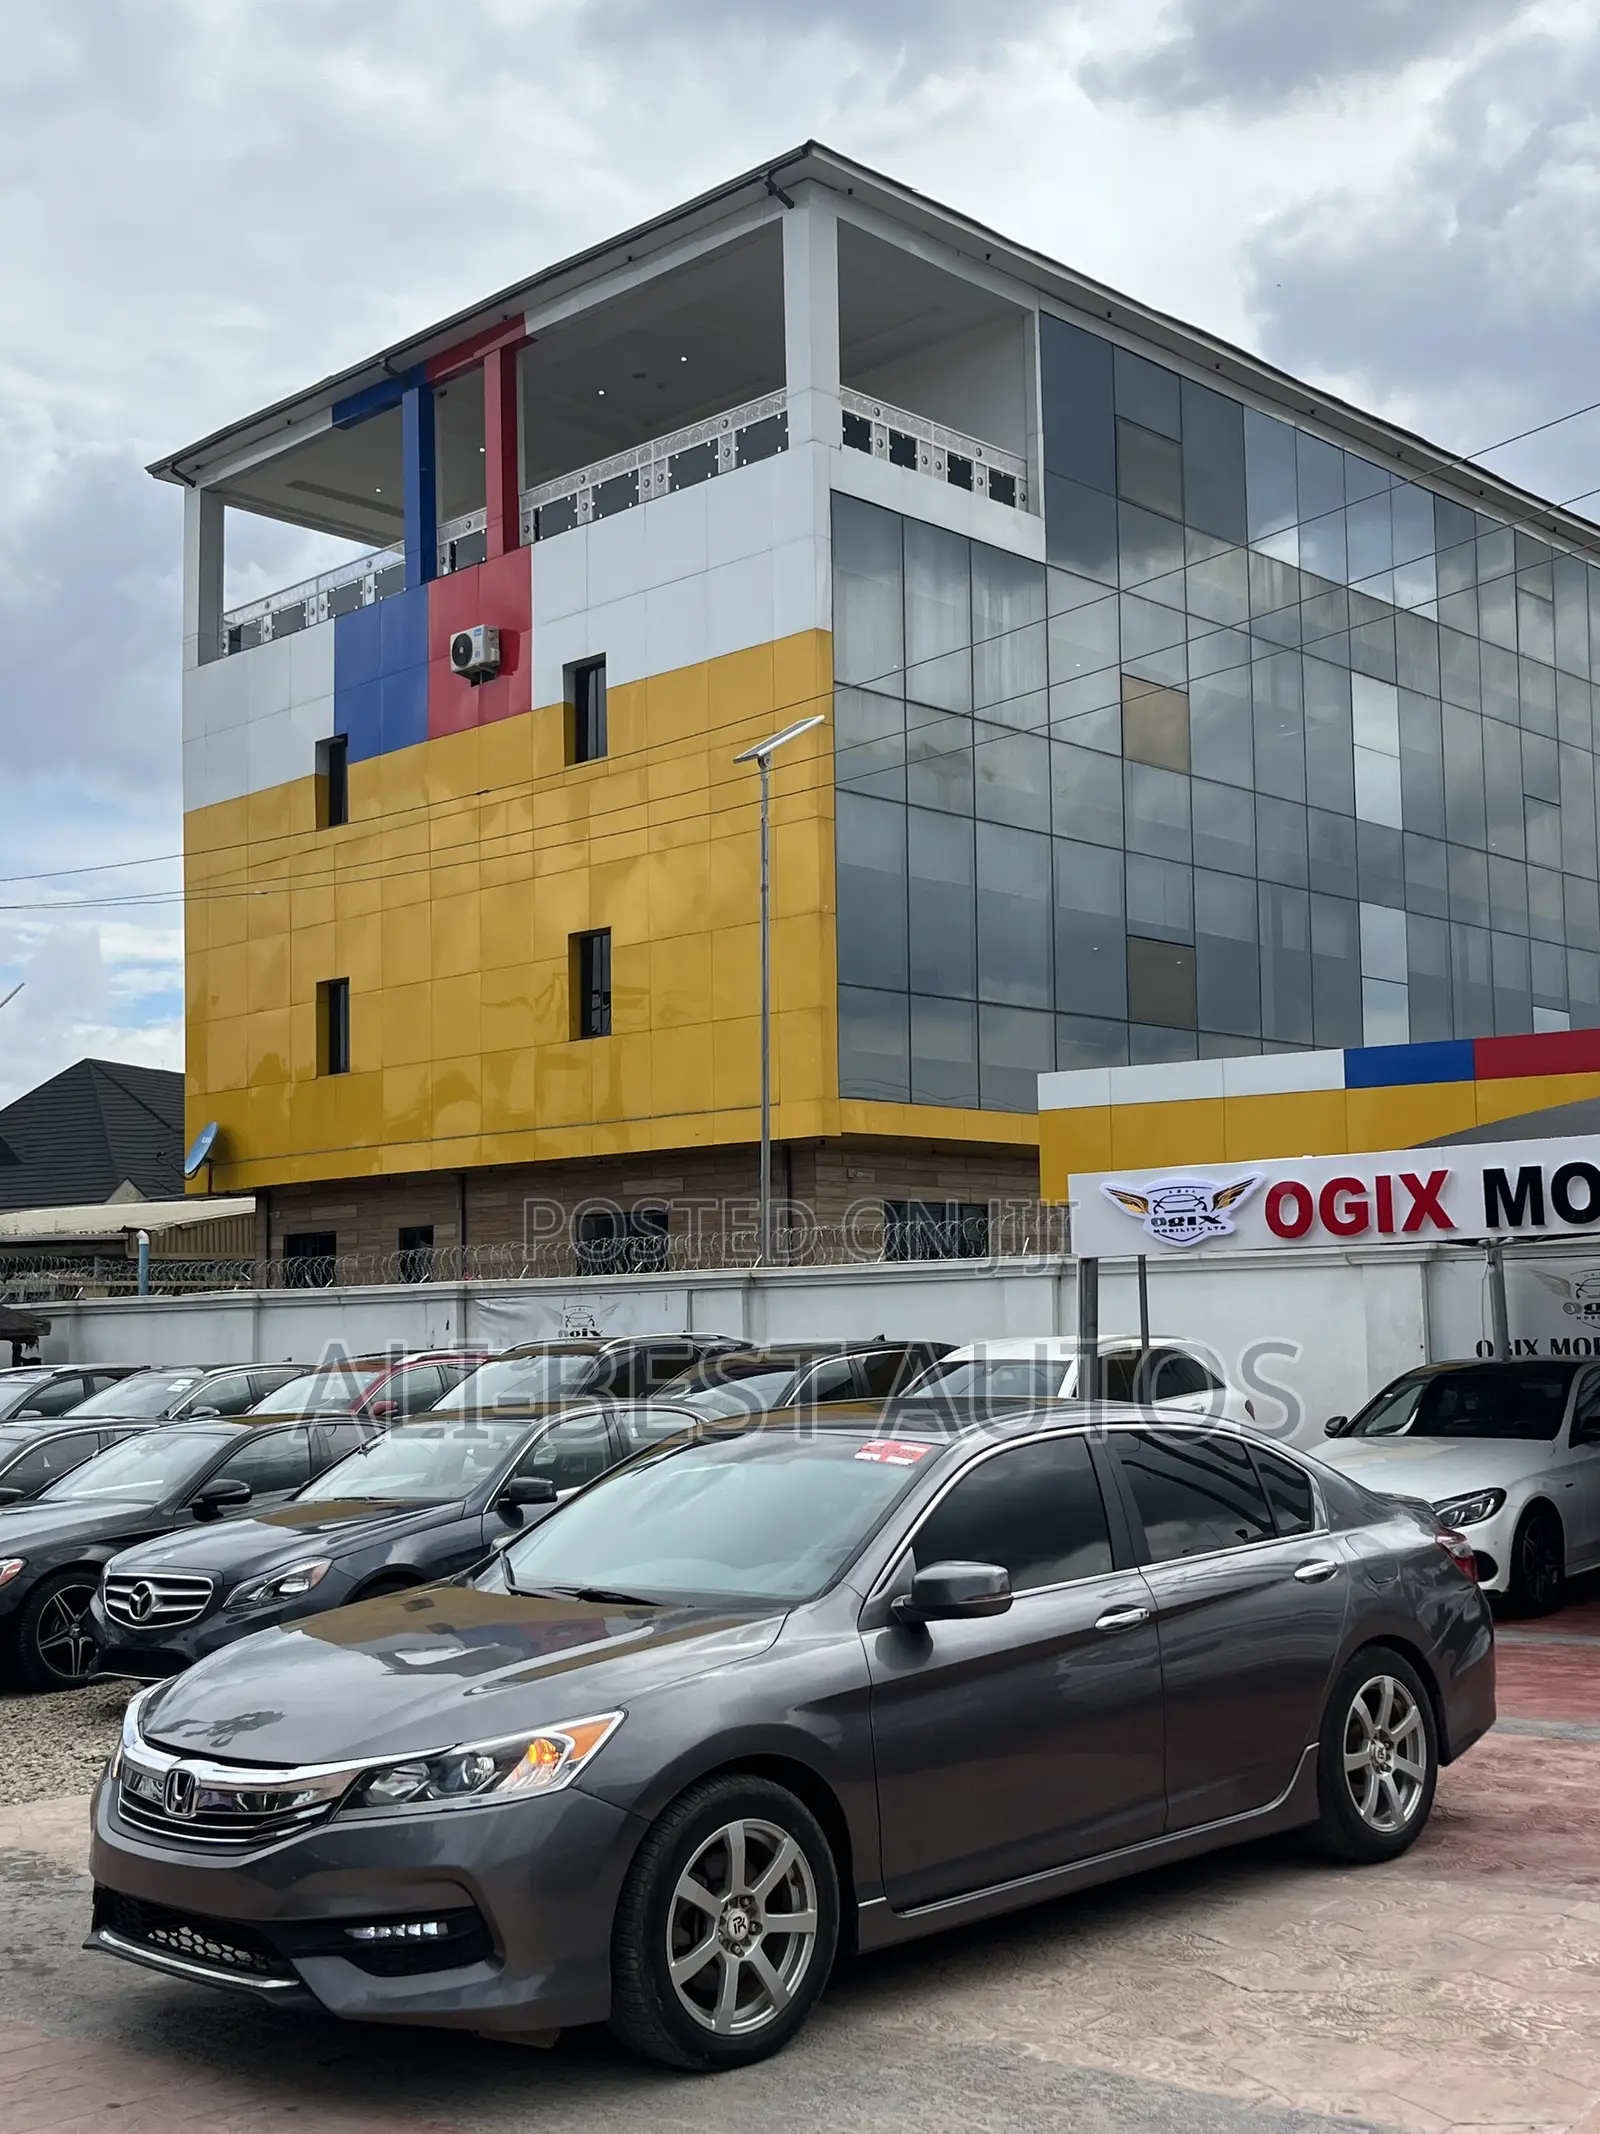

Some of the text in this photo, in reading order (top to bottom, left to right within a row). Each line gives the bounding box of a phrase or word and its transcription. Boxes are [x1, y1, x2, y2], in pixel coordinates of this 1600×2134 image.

[1264, 1161, 1600, 1239] OGIX MO
[1475, 1338, 1539, 1358] OIX
